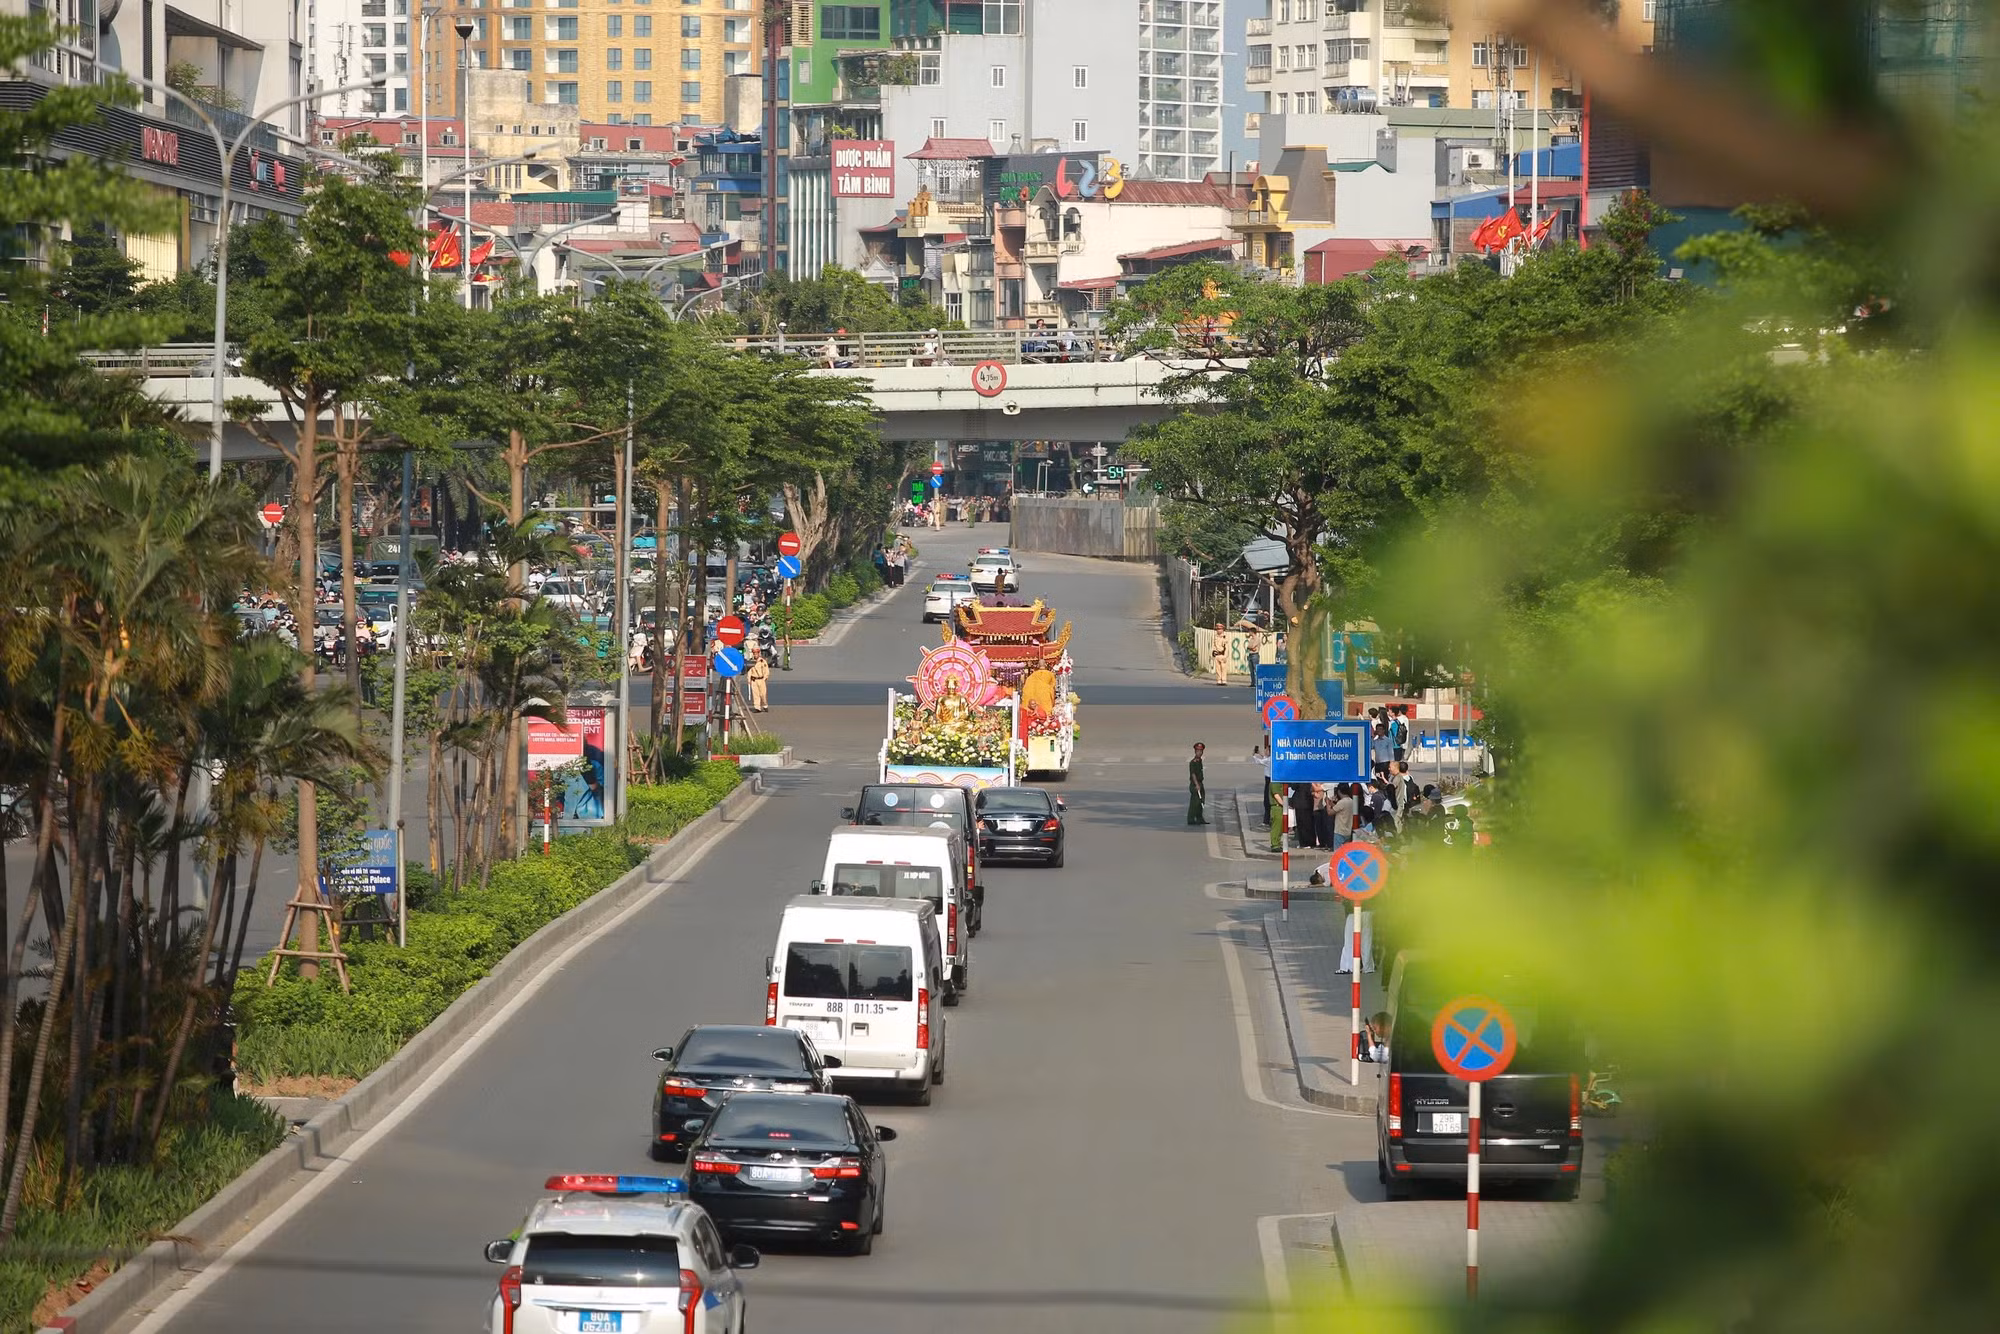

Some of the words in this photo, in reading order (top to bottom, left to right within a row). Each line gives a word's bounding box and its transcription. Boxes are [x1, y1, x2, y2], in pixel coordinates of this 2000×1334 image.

[836, 149, 861, 171] DƯỢC
[864, 143, 891, 168] PHẨM
[838, 173, 861, 194] TÂM
[864, 173, 890, 194] BÌNH
[1277, 737, 1291, 747] NHÀ
[1293, 737, 1316, 747] KHÁCH
[1318, 739, 1328, 747] LA
[1329, 737, 1352, 748] THÀNH
[1276, 752, 1284, 760] La
[1285, 752, 1306, 760] Thanh
[1307, 752, 1327, 760] Guest
[1328, 752, 1349, 760] House
[370, 875, 391, 884] Palace
[827, 1002, 843, 1012] 88B
[854, 1003, 884, 1014] 011.35
